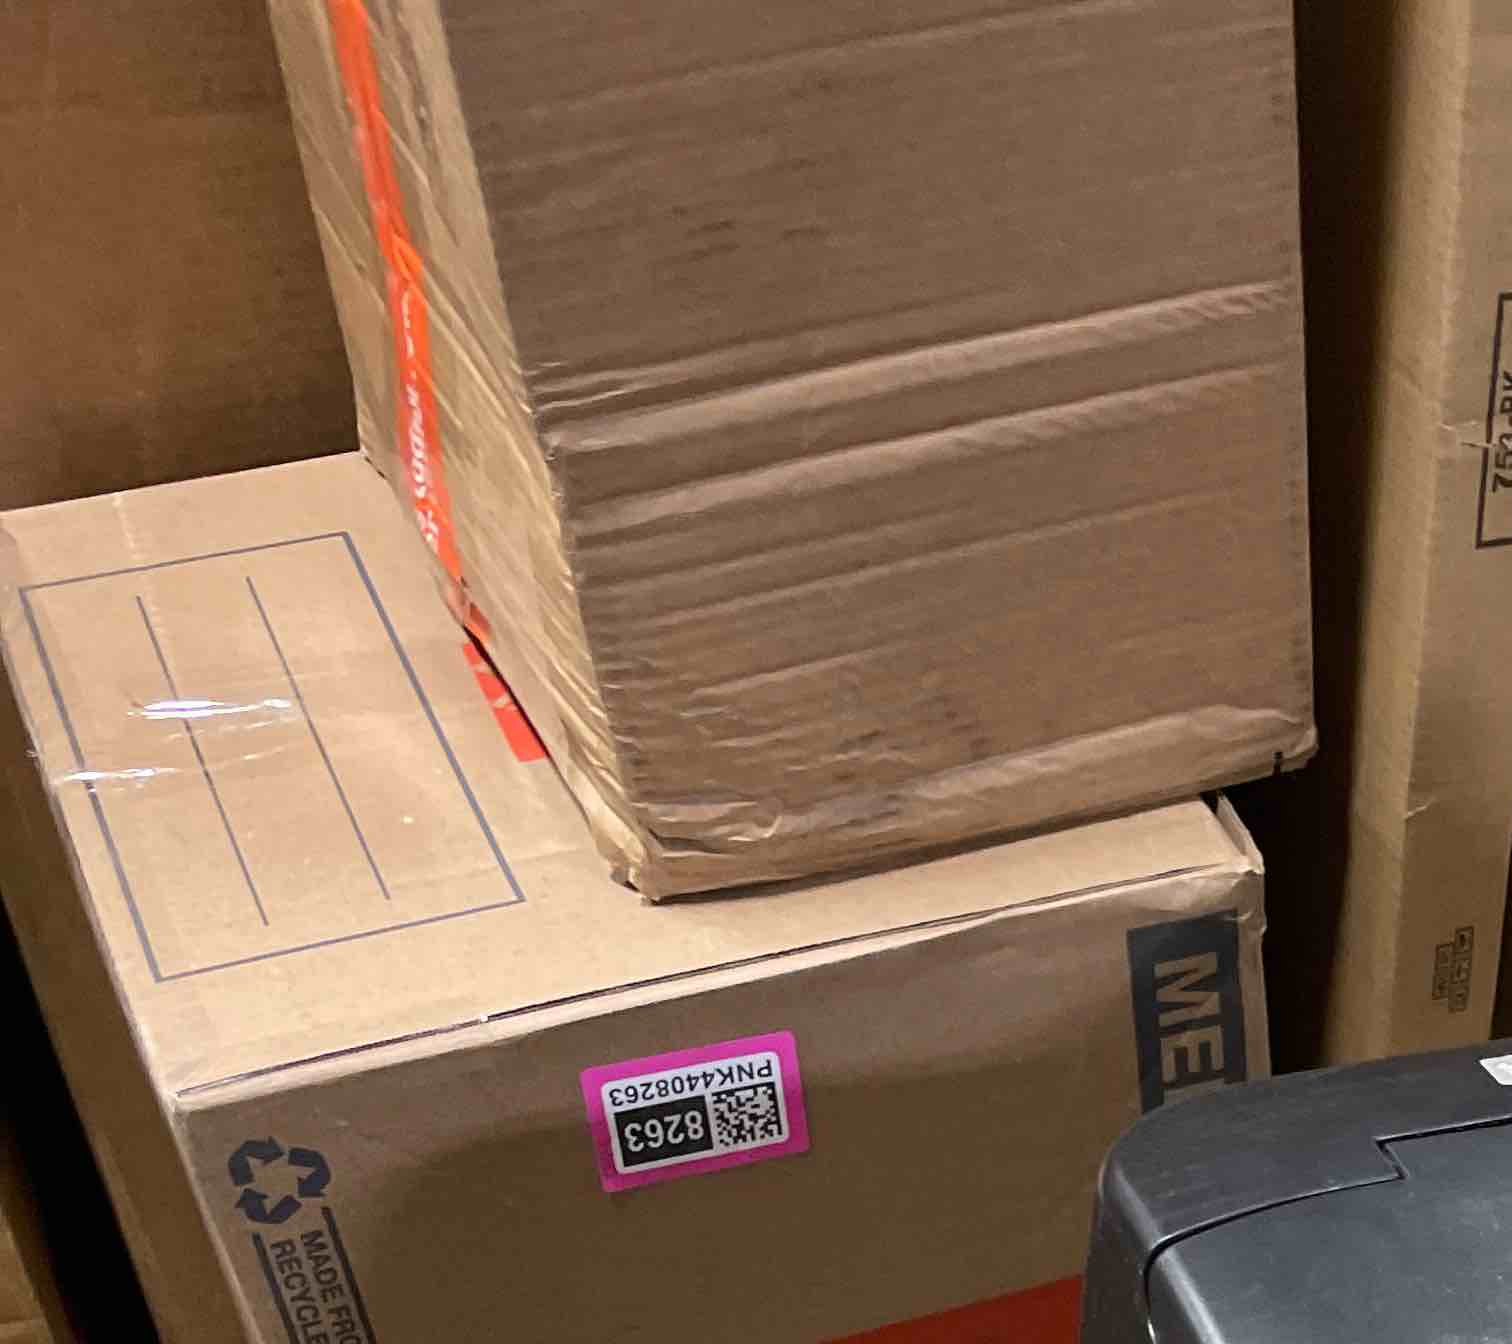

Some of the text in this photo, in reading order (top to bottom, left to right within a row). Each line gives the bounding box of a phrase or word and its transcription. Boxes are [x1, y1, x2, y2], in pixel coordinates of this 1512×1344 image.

[608, 1058, 774, 1108] PNK4408263
[623, 1110, 705, 1153] 8263
[300, 1230, 344, 1303] MADE
